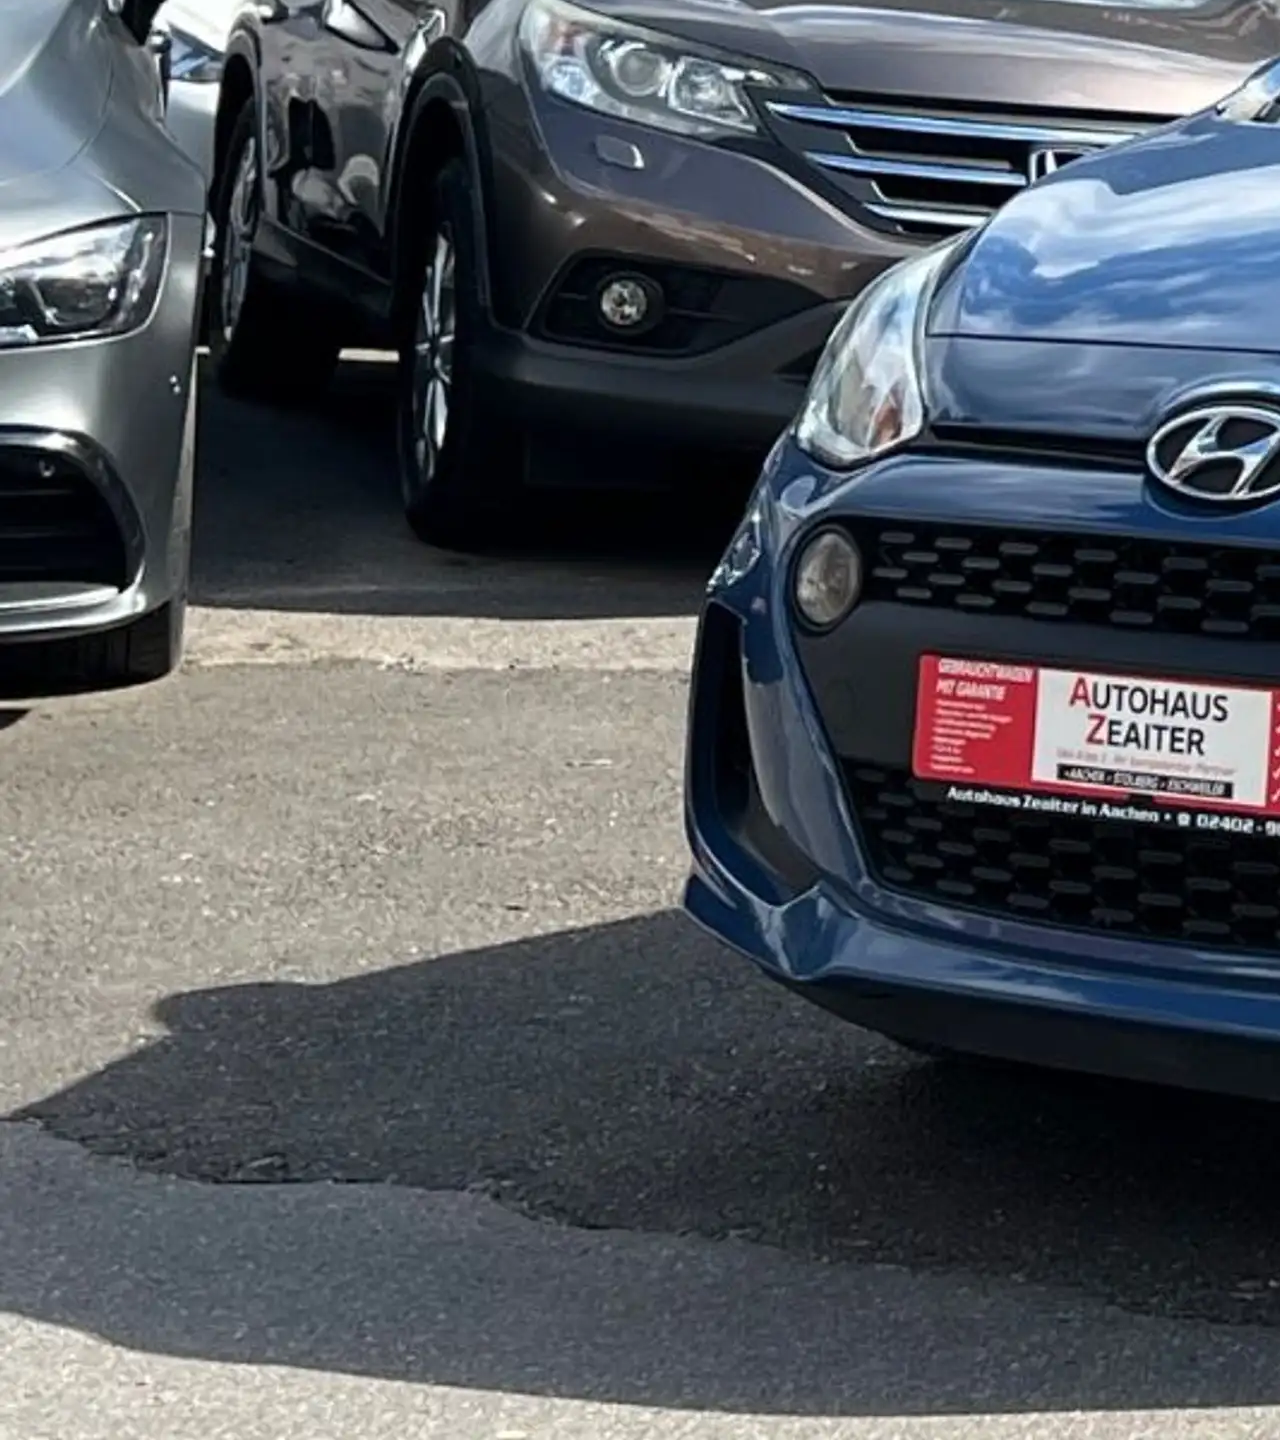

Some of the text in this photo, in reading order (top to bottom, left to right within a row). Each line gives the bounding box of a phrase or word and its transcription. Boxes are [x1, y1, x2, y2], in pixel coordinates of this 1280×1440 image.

[1069, 676, 1229, 722] AUTOHAUS
[1085, 713, 1205, 757] ZEAITER
[947, 786, 1021, 808] Autohaus
[1022, 793, 1078, 814] Zeaiter
[1081, 801, 1097, 816] in
[1099, 803, 1160, 823] Aachen
